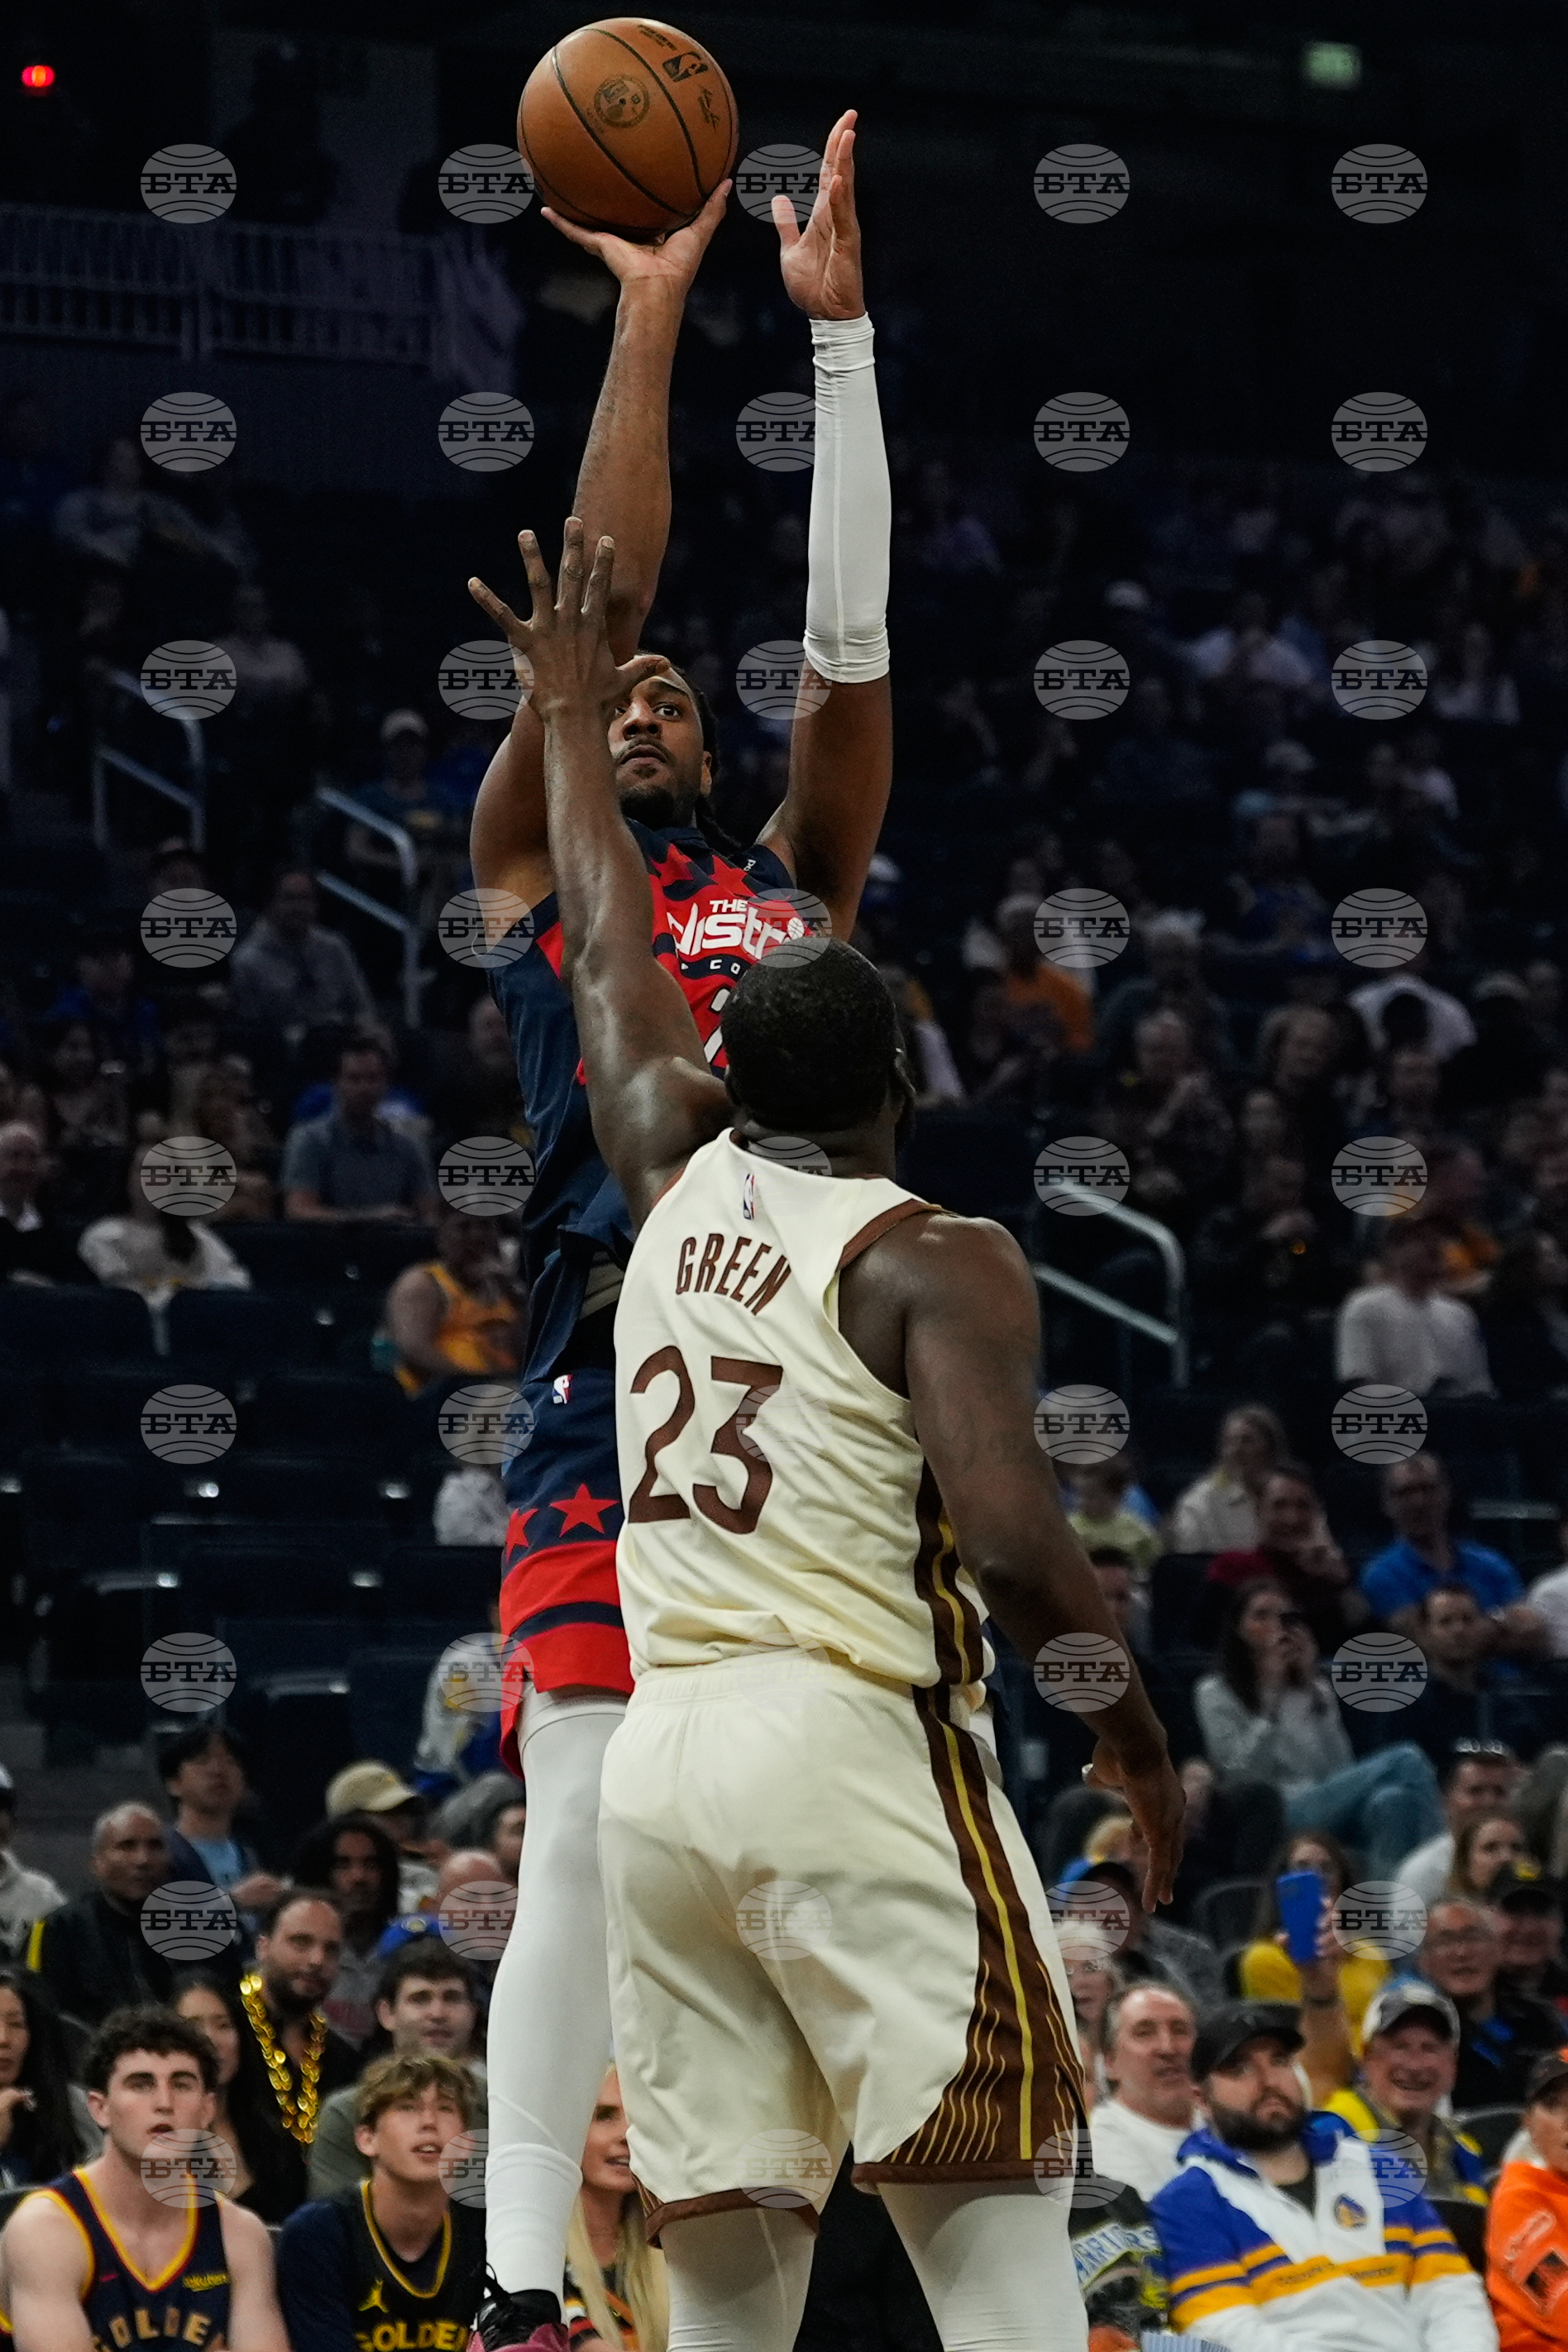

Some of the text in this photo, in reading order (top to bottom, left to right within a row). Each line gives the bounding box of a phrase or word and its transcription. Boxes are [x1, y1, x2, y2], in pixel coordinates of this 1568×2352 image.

[709, 899, 748, 913] THE
[676, 1233, 791, 1317] GREEN
[628, 1345, 783, 1535] 23
